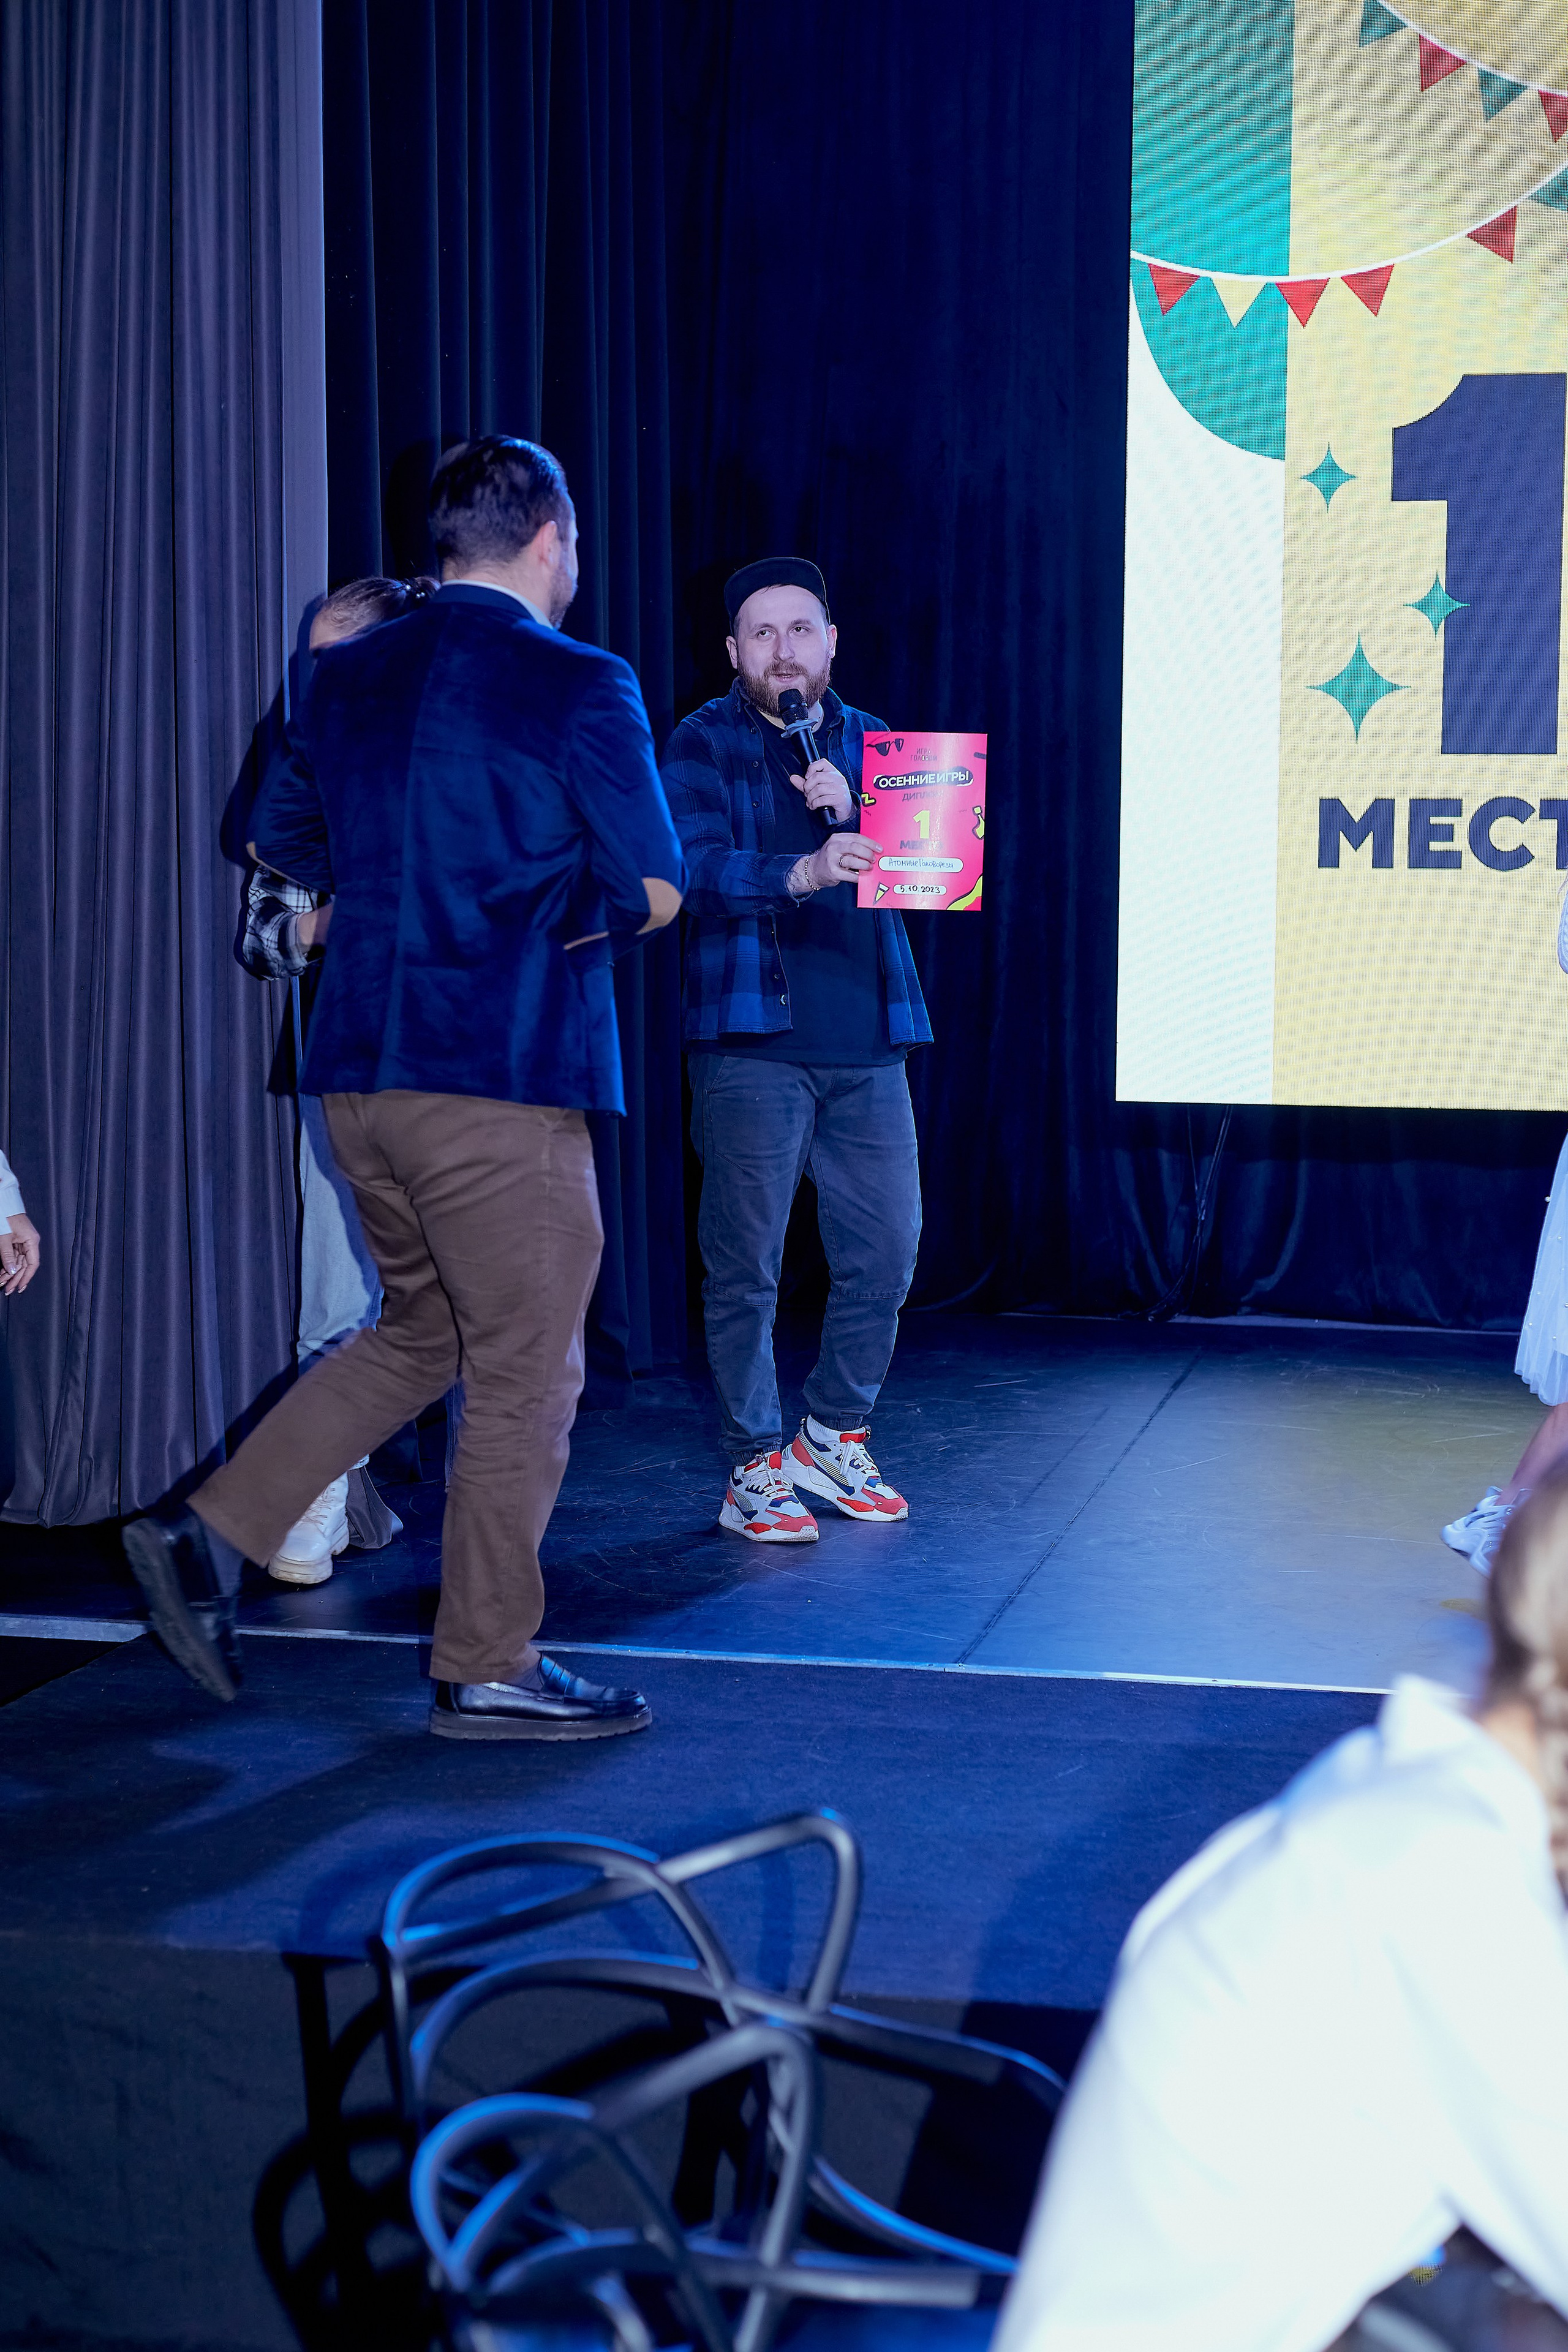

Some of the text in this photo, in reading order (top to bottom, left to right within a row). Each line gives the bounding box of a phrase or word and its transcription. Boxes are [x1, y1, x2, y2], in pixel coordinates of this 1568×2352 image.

[1392, 372, 1567, 754] 1
[878, 771, 969, 788] ОСЕННИЕ ИГРЫ
[913, 810, 930, 839] 1
[889, 858, 954, 869] Атомные Головорезы
[900, 884, 941, 894] 5.10.2023
